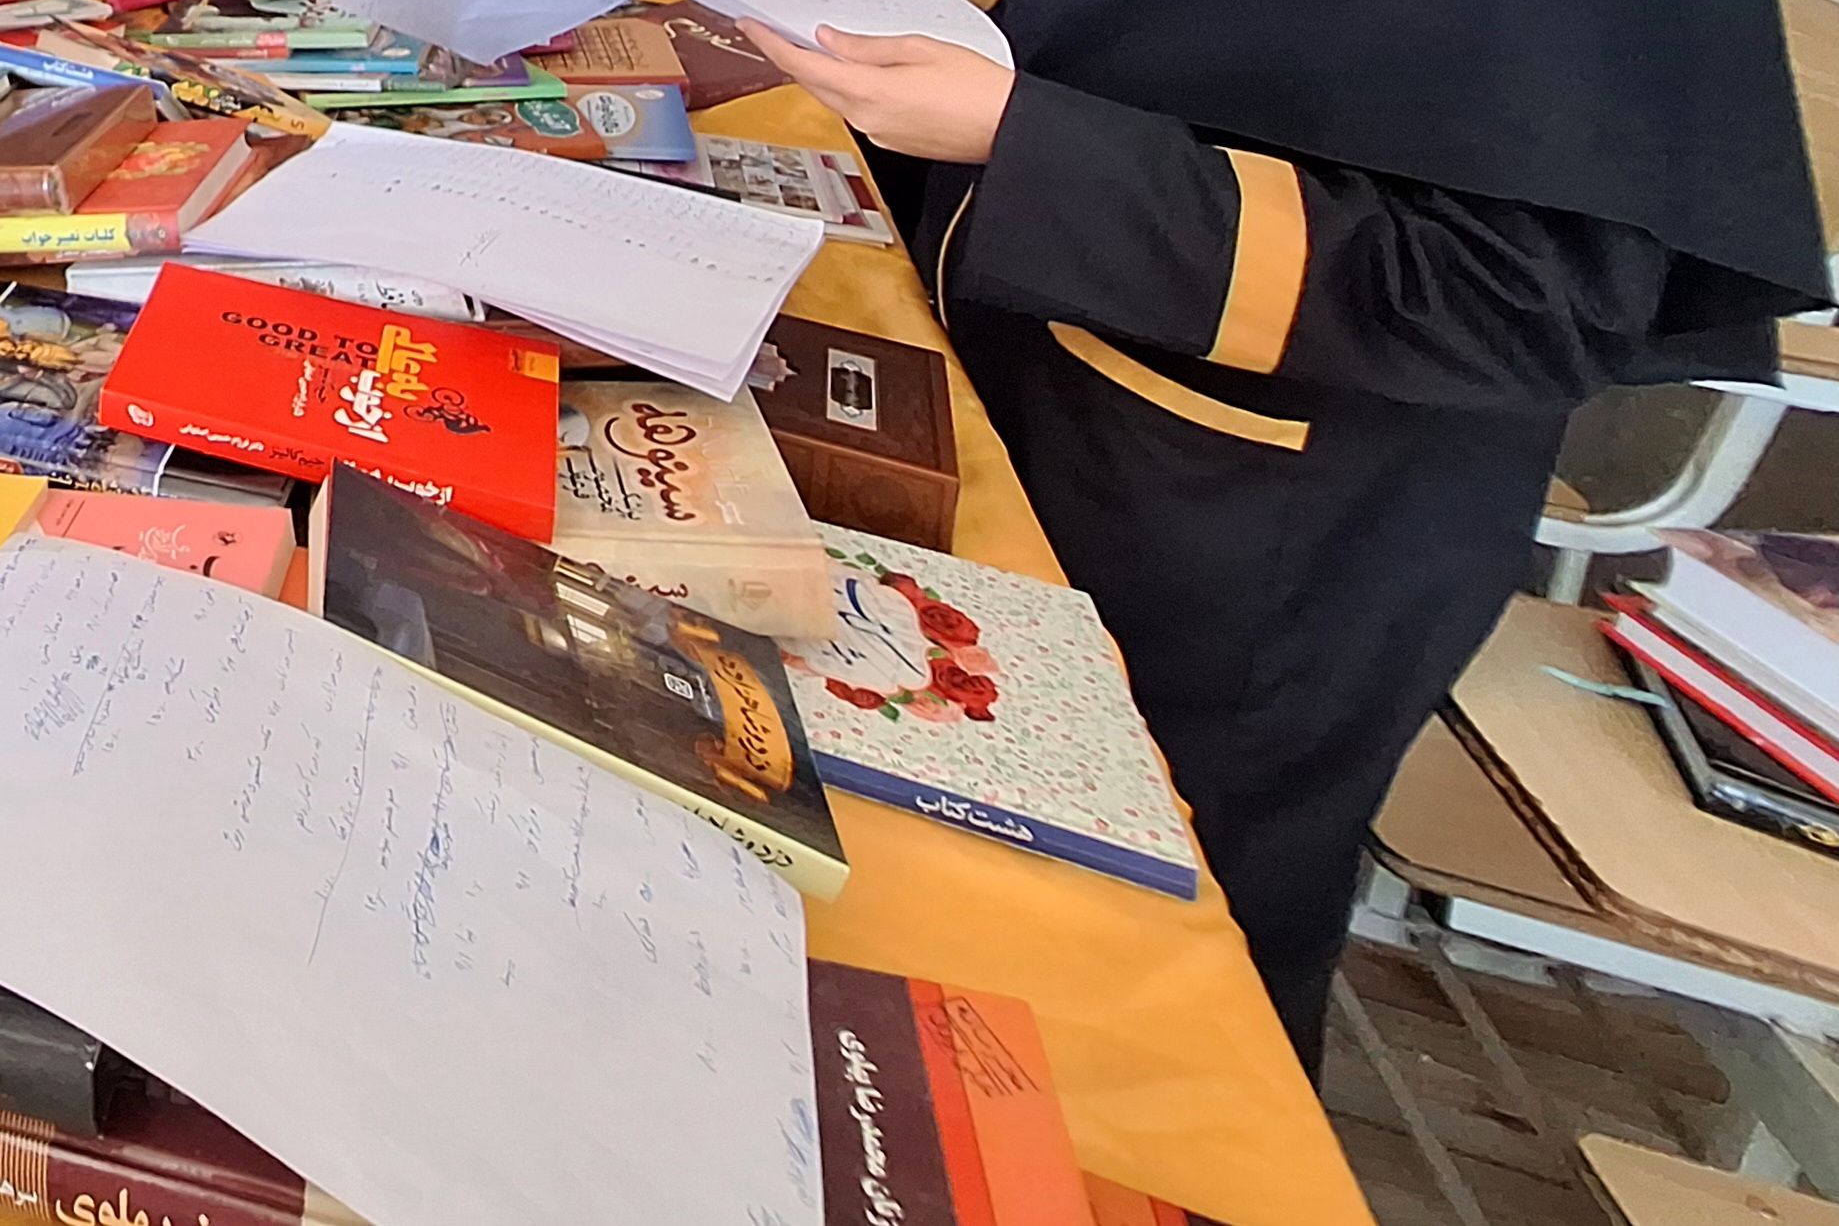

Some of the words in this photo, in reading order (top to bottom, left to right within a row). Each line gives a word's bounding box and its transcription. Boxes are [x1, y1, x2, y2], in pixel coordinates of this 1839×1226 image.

[20, 230, 53, 247] خواب
[56, 229, 81, 247] تعبیر
[83, 227, 116, 242] کلیات
[221, 310, 319, 343] GOOD
[333, 334, 380, 357] TO
[258, 332, 377, 371] GREAT
[604, 402, 698, 522] سینوهه
[914, 792, 972, 822] کتاب
[968, 812, 1036, 843] هشت
